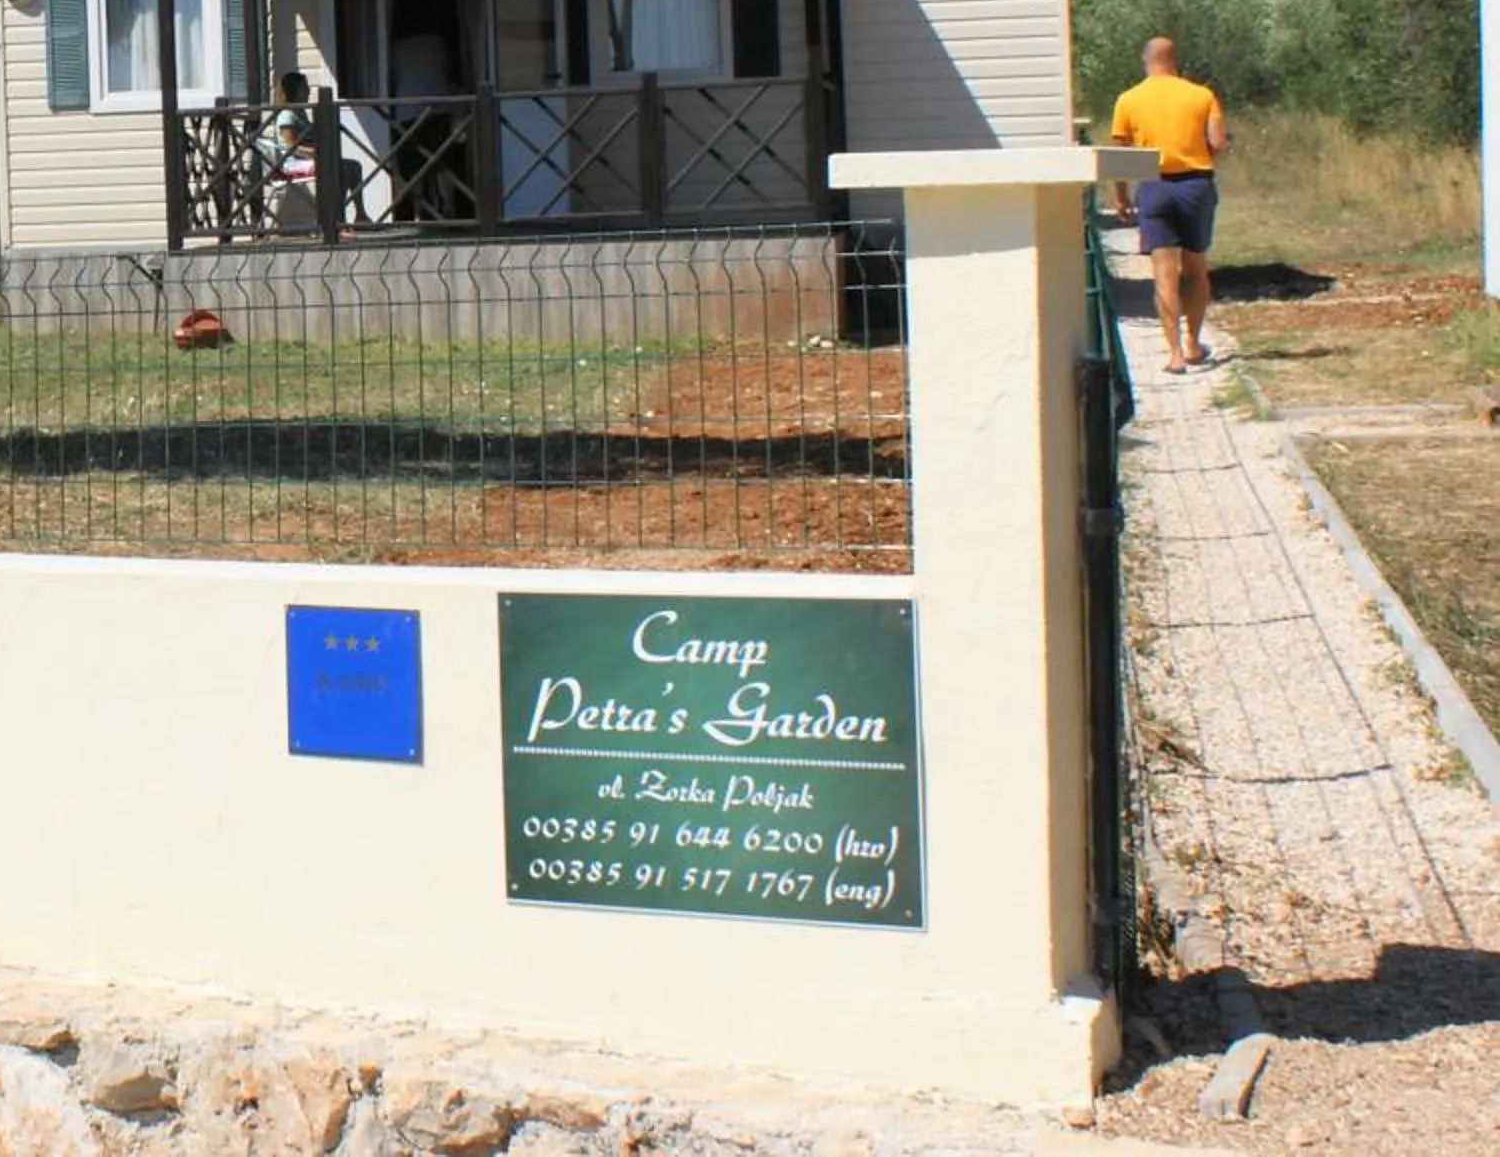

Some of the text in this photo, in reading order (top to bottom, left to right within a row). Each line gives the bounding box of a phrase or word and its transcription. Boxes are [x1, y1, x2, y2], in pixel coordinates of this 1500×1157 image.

[633, 610, 769, 678] Camp
[527, 677, 887, 747] Petra's Garden
[635, 769, 716, 804] Zorka
[722, 775, 815, 813] Poljak
[523, 817, 617, 843] 00385
[629, 822, 660, 846] 91
[675, 821, 731, 849] 644
[743, 826, 824, 855] 6200
[528, 858, 896, 909] 00385 91 517 1767 (eng)
